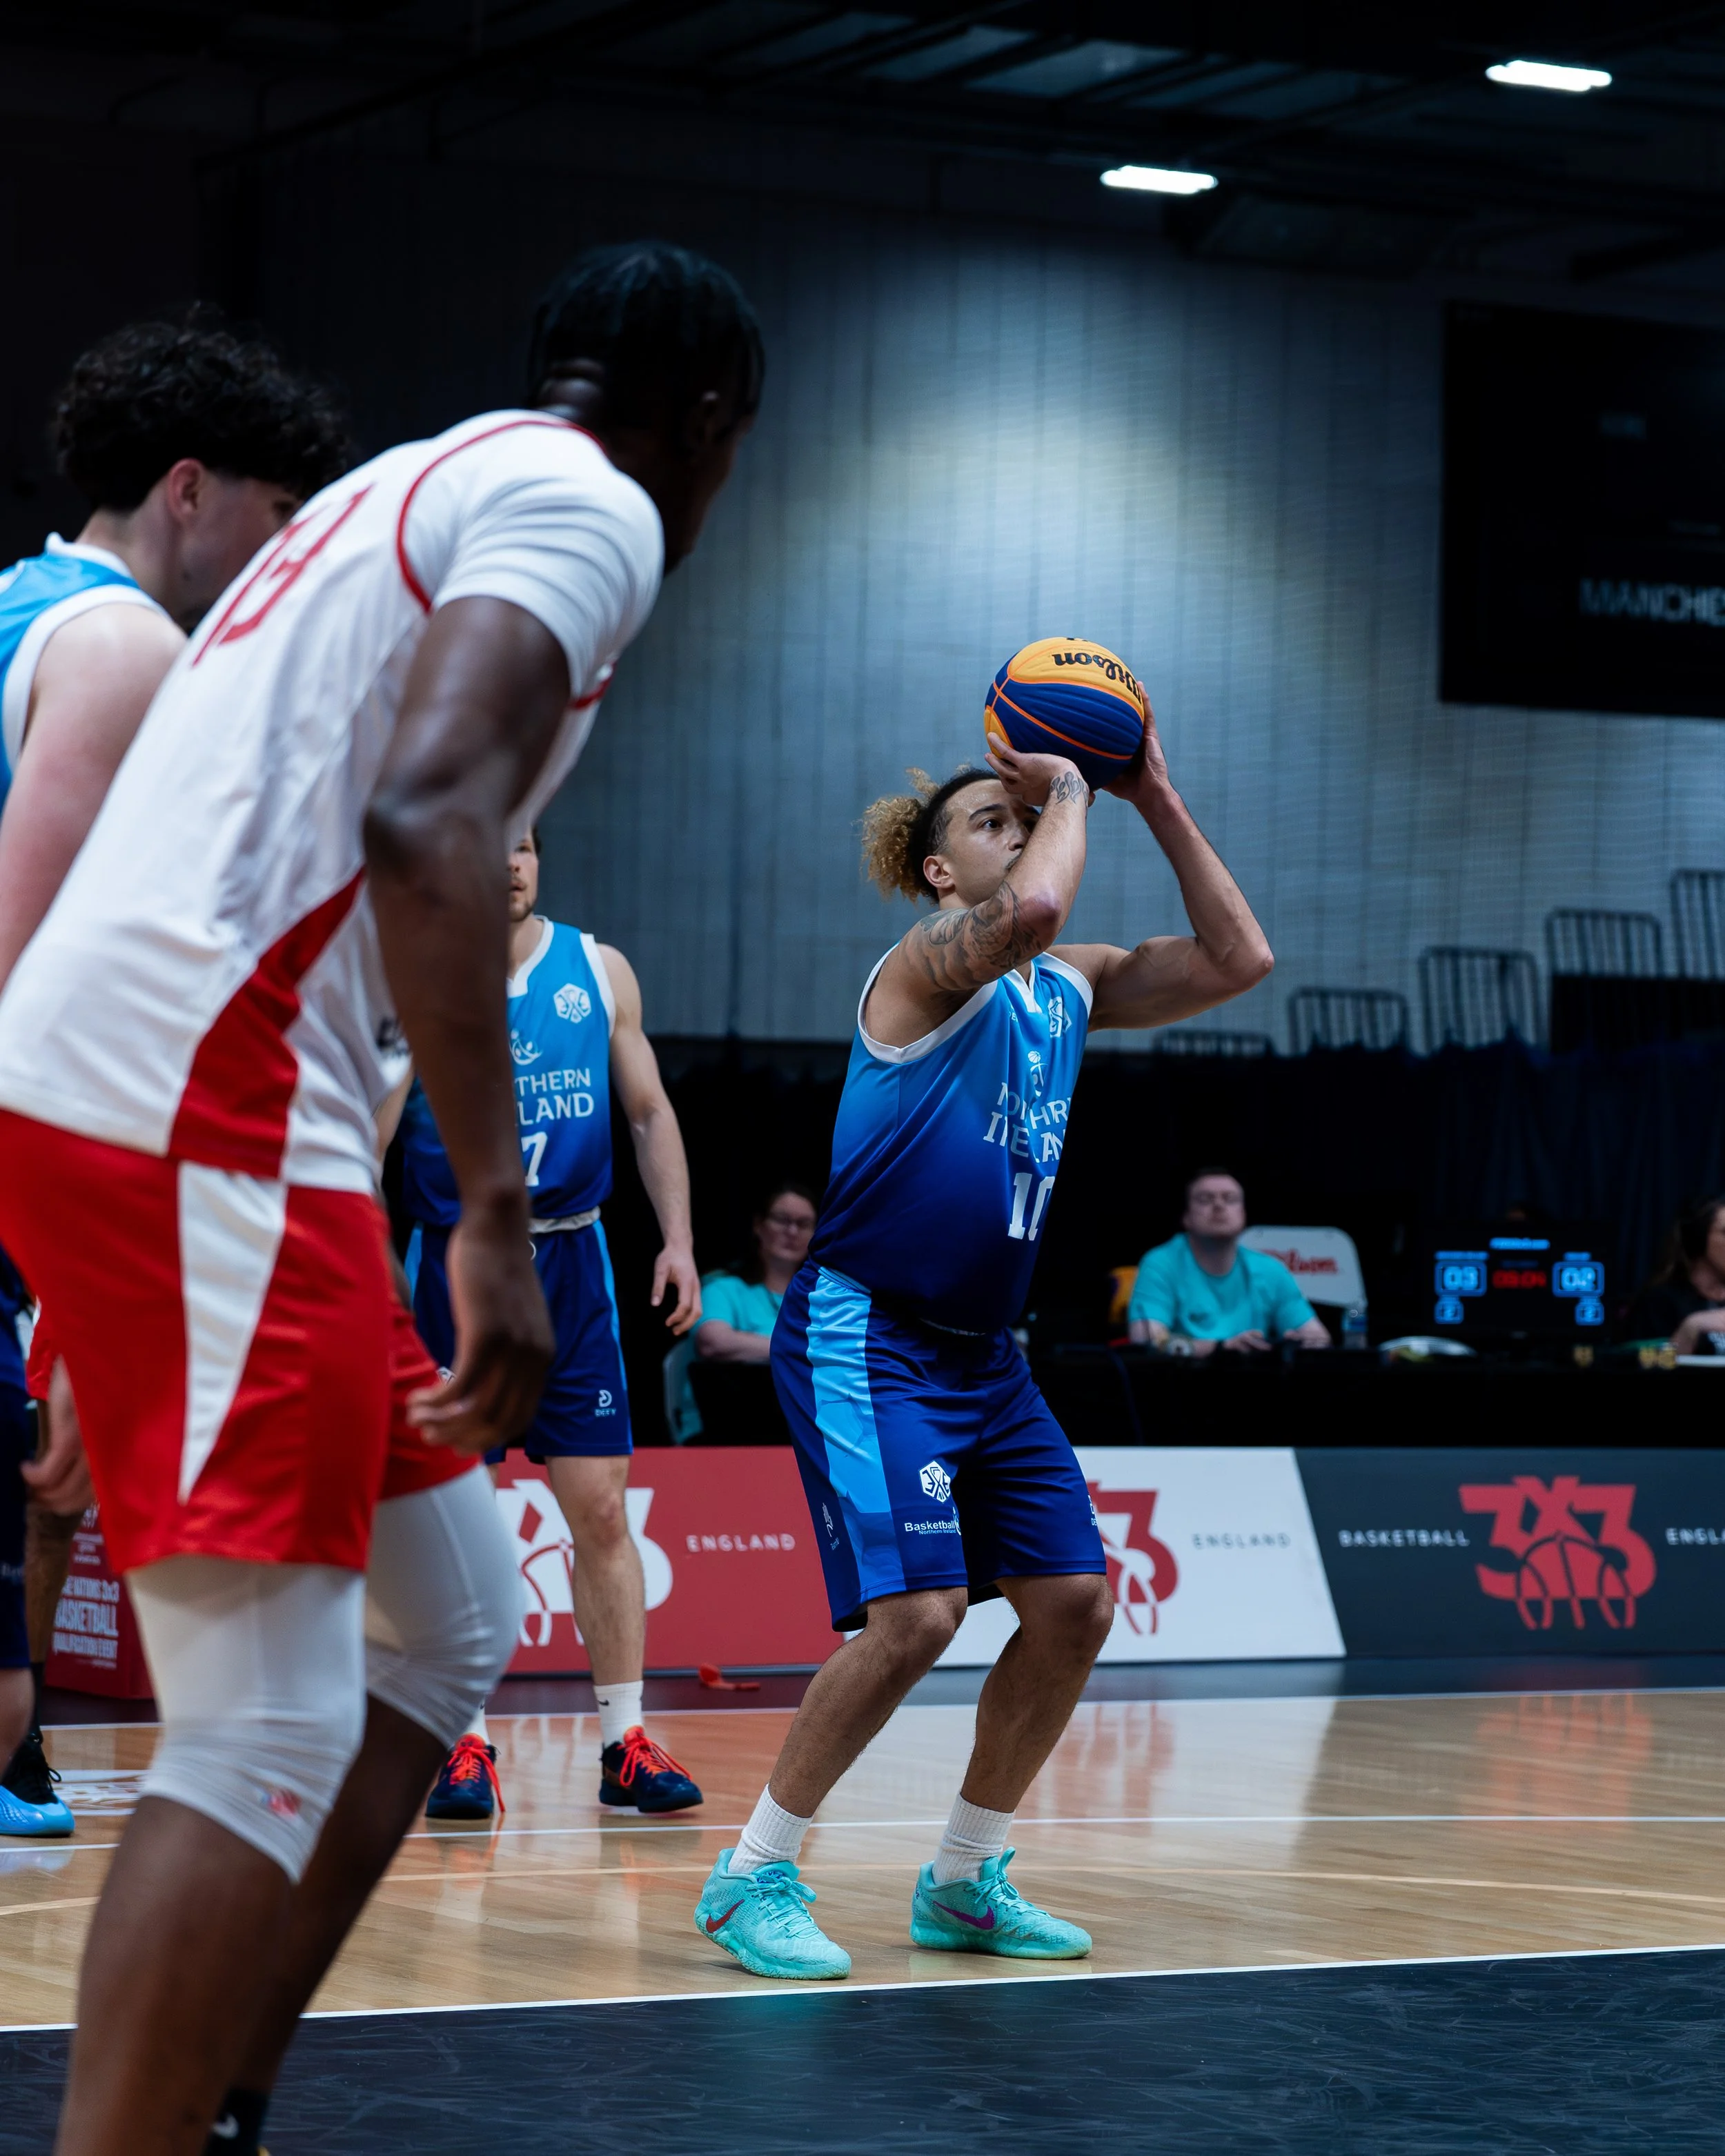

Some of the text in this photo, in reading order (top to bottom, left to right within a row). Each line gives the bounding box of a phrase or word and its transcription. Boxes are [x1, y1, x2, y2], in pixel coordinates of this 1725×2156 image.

[515, 1067, 591, 1097] THERN
[519, 1092, 595, 1126] LAND
[686, 1533, 796, 1552] ENGLAND
[1192, 1532, 1291, 1550] ENGLAND
[1338, 1529, 1470, 1547] BASKETBALL
[1665, 1527, 1725, 1545] ENGL
